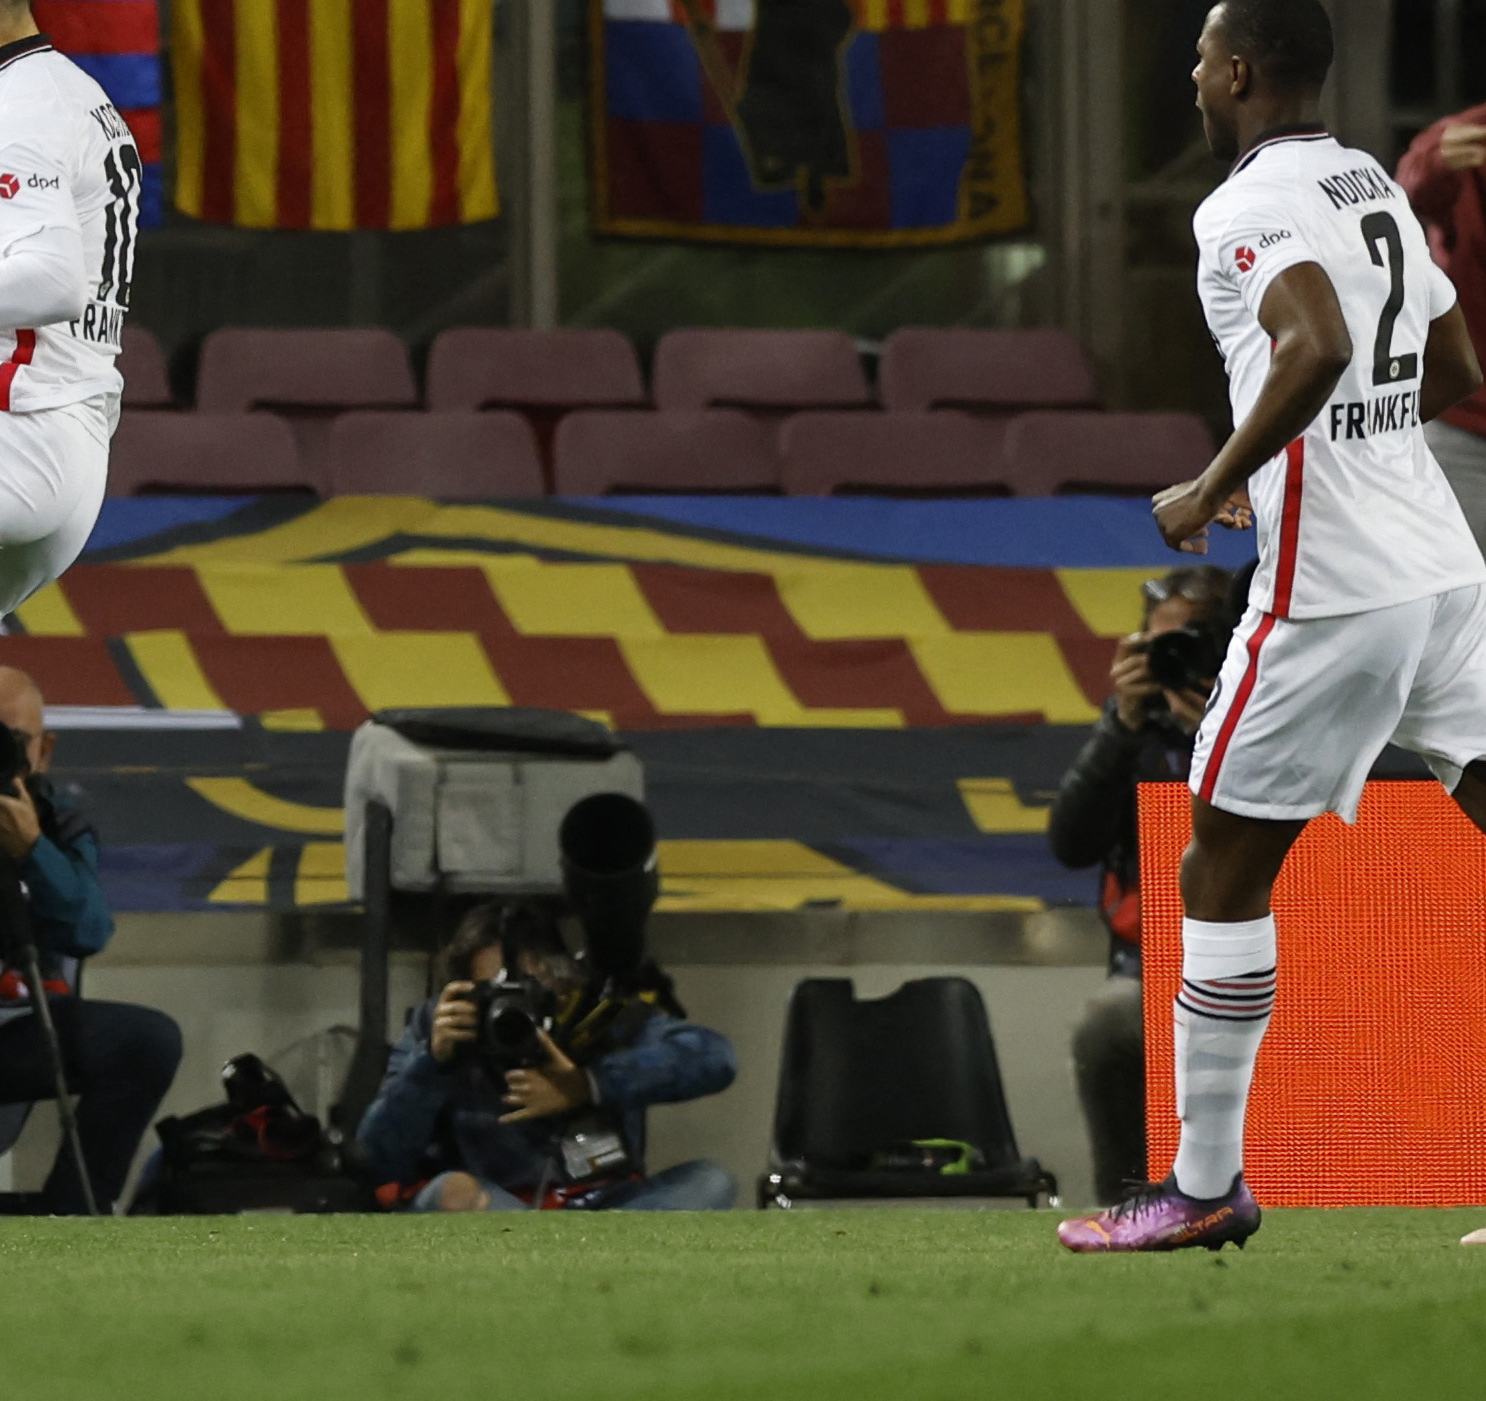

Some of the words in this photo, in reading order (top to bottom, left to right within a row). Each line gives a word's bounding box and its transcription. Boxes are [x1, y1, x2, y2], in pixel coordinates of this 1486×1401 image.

[27, 173, 60, 189] dpd
[1317, 167, 1395, 210] NDICKA
[1360, 210, 1418, 387] 2
